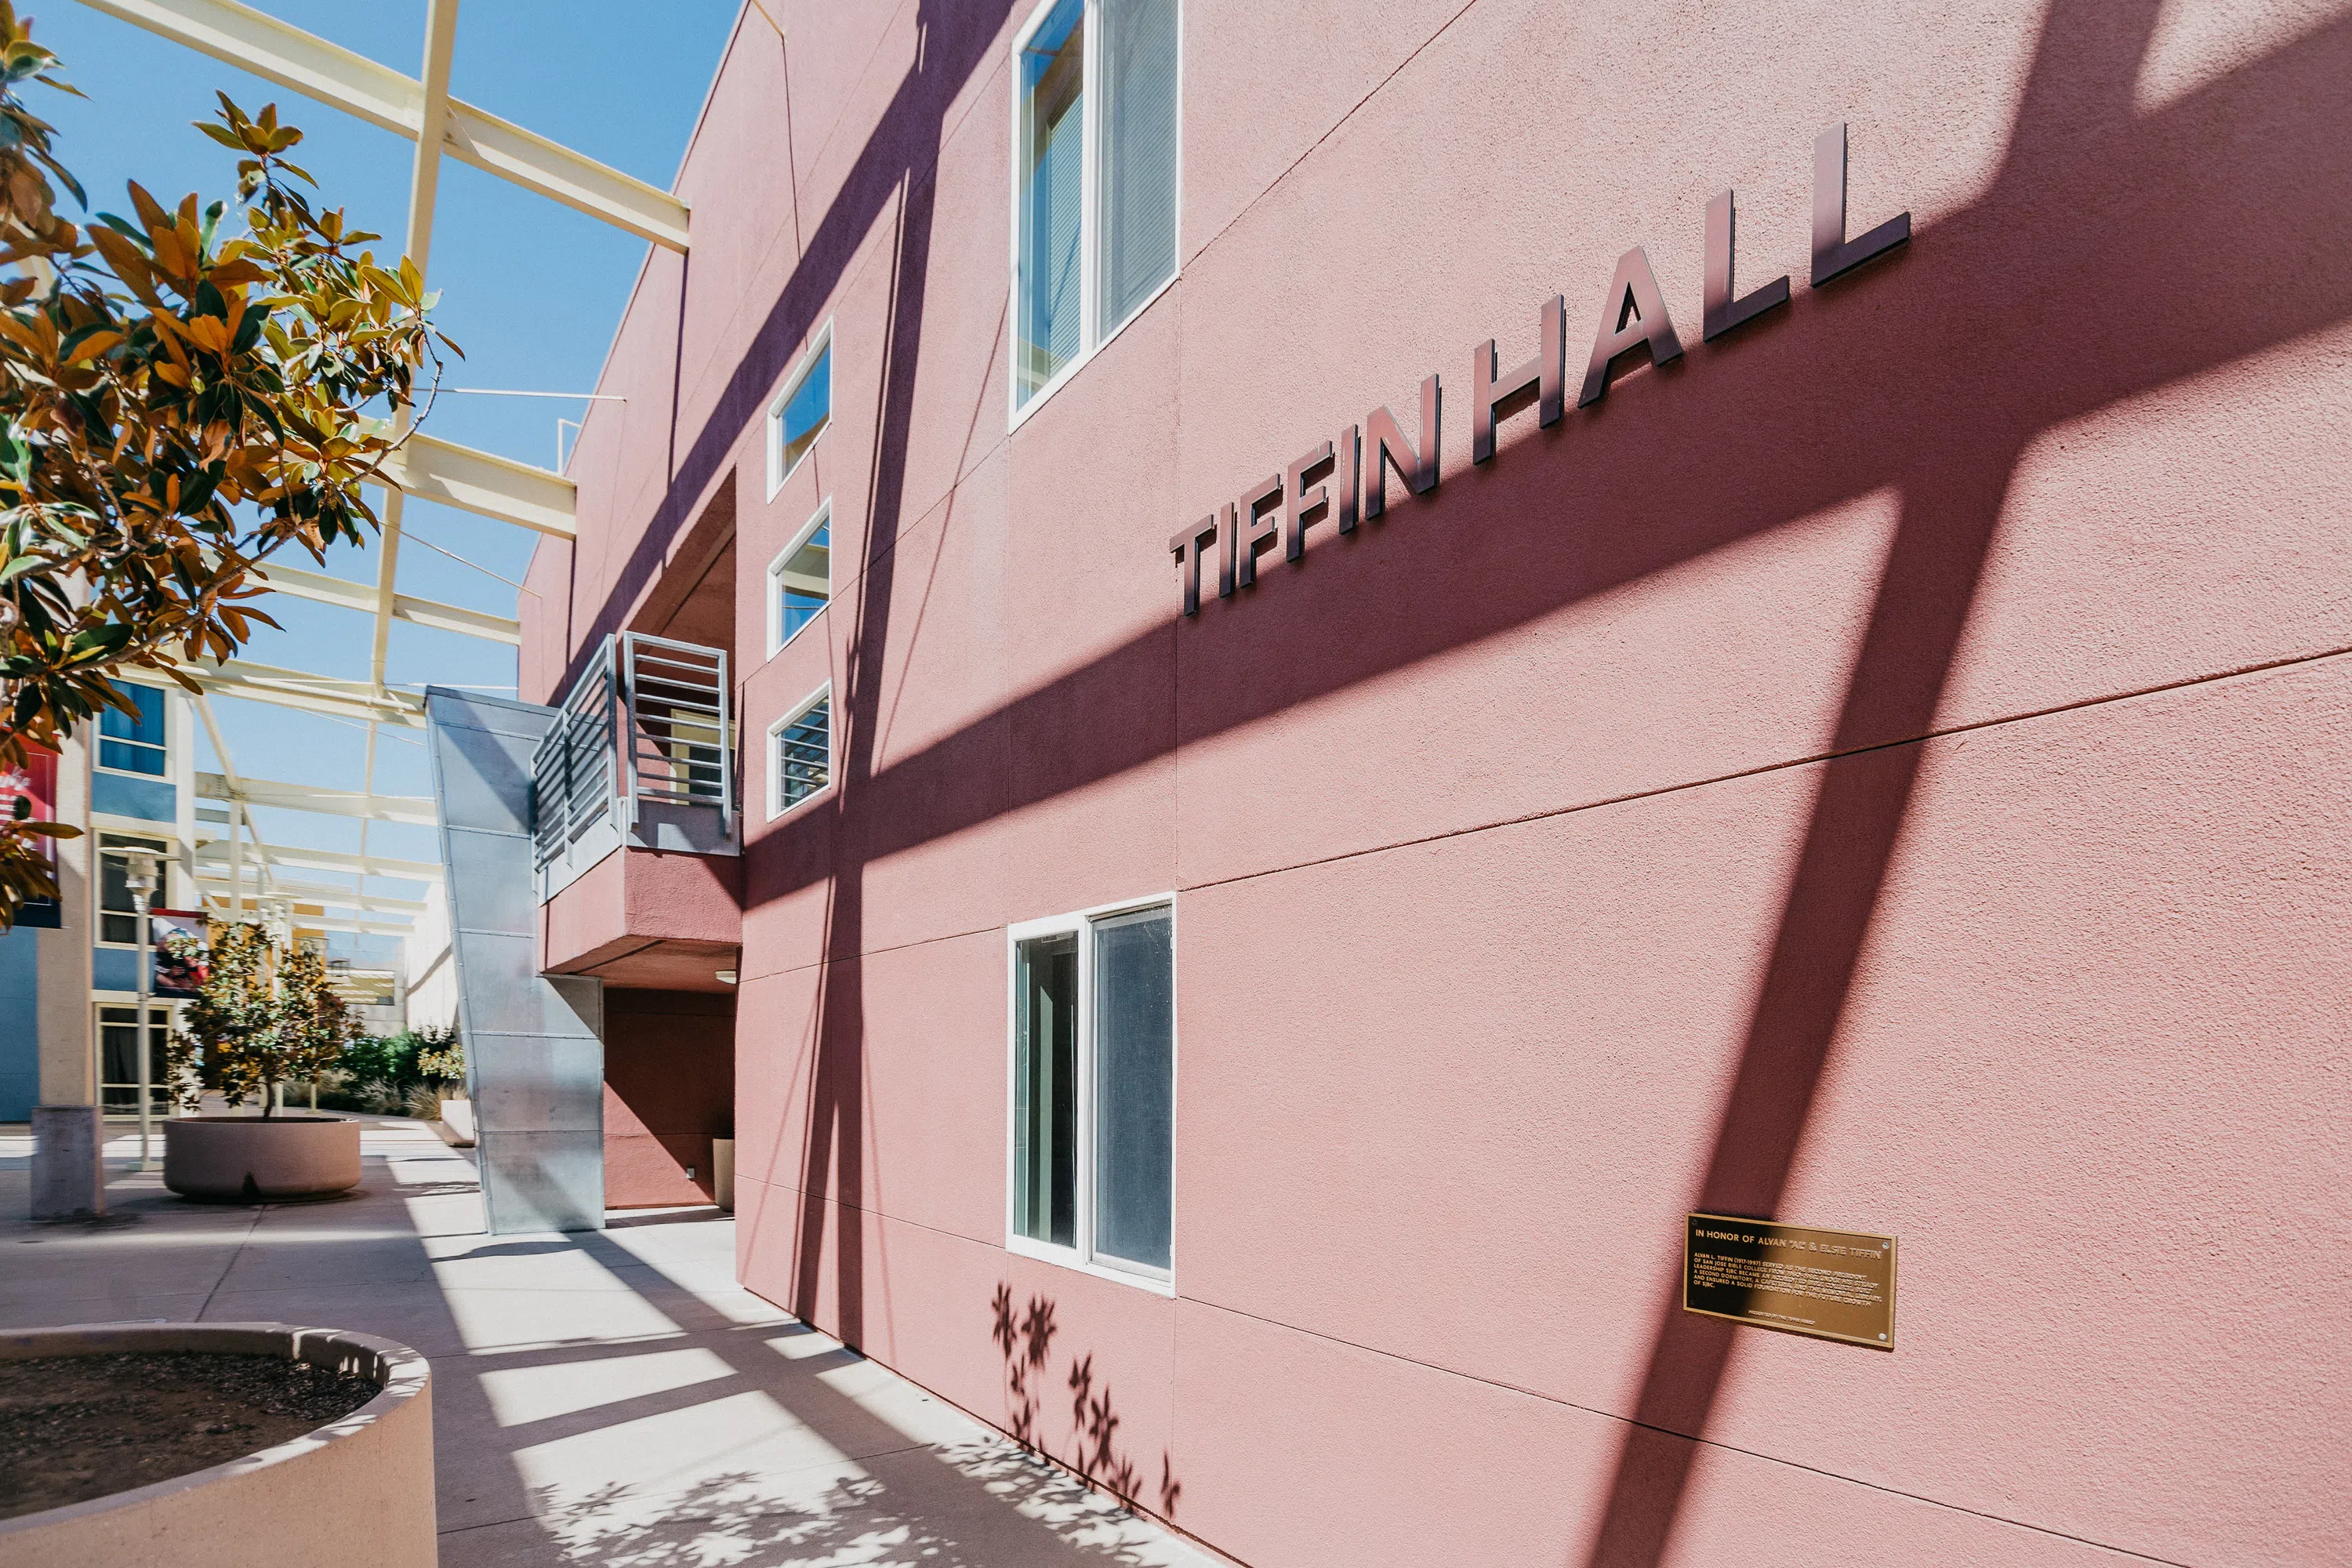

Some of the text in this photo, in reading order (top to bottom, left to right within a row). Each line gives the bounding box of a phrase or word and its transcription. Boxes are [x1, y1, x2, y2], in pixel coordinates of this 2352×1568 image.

[1169, 121, 1911, 617] TIFFIN HALL
[1707, 1231, 1739, 1241] HONOR
[1742, 1235, 1755, 1243] OF
[1759, 1237, 1786, 1247] ALVAN
[1820, 1244, 1846, 1255] ELSIE
[1849, 1248, 1881, 1259] TIFFIN
[1694, 1263, 1724, 1272] LEADERSHIP
[1772, 1275, 1806, 1284] ACCREDITED
[1734, 1258, 1761, 1266] (1917-1997)
[1833, 1272, 1867, 1281] PRESIDENT
[1744, 1265, 1768, 1273] COLLEGE
[1854, 1281, 1878, 1290] STEADY
[1755, 1284, 1791, 1294] FOUNDATION
[1843, 1298, 1871, 1307] GROWTH
